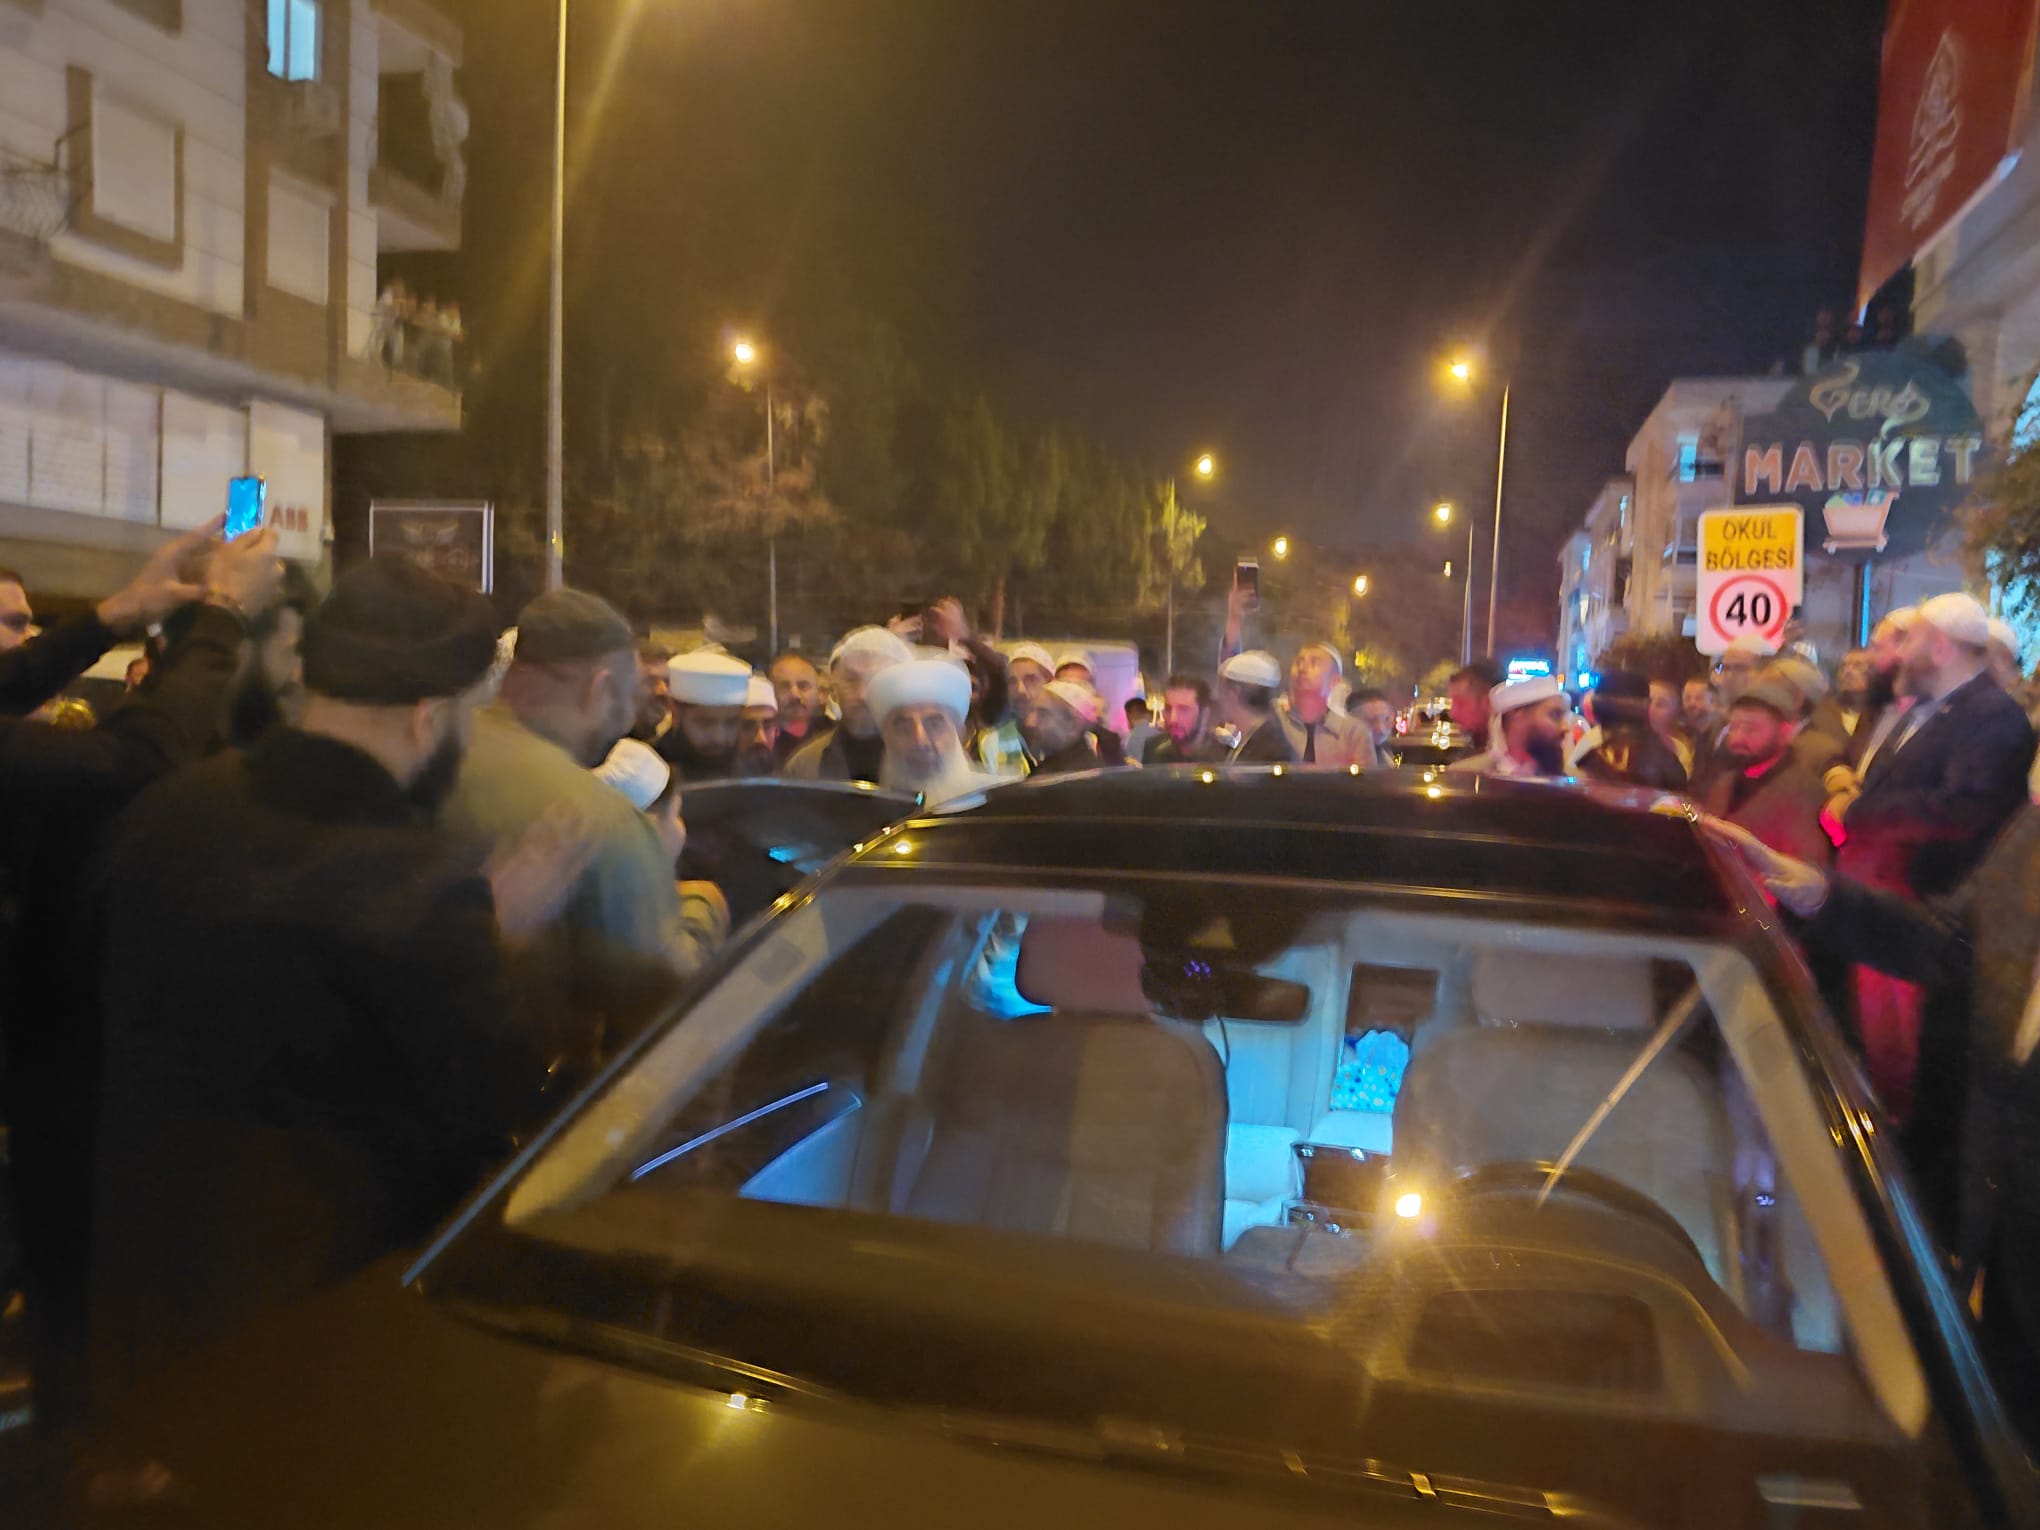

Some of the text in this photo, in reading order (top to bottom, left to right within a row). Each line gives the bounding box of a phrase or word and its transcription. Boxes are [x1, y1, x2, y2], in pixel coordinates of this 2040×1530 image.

[1744, 435, 1982, 495] MARKET
[1721, 517, 1778, 542] OKUL
[1705, 544, 1796, 571] BÖLGESİ
[1725, 592, 1772, 628] 40
